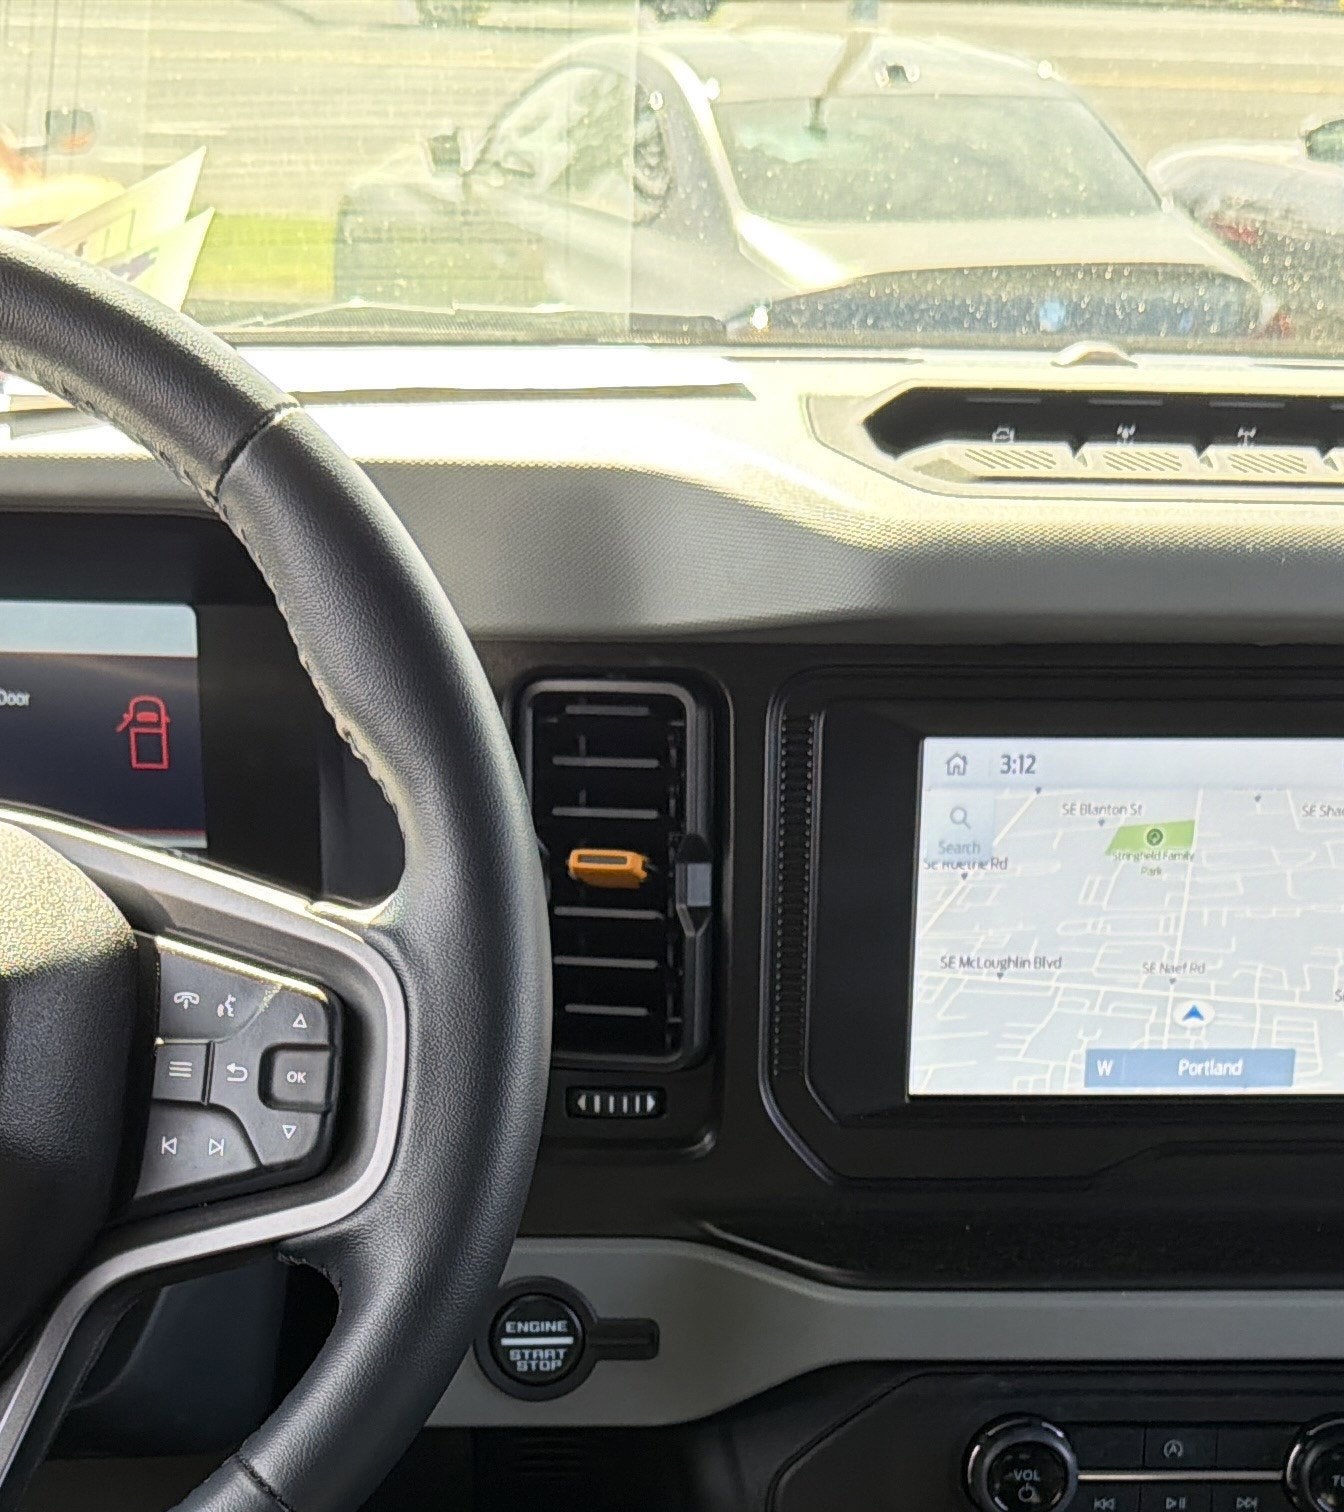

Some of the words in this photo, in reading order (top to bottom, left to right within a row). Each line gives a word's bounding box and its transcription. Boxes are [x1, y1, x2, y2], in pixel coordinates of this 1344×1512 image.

[999, 754, 1037, 775] 3:12
[1062, 803, 1077, 816] SE
[1079, 803, 1120, 816] Blanton
[1123, 803, 1143, 816] St
[1301, 804, 1317, 817] SE
[938, 840, 981, 855] Search
[940, 957, 956, 969] SE
[959, 956, 1031, 971] McLoughlin
[1034, 956, 1063, 969] Blvd
[1142, 962, 1157, 974] SE
[1189, 962, 1205, 974] Rd
[1096, 1059, 1113, 1077] W
[1178, 1058, 1243, 1077] Portland
[286, 1071, 307, 1084] OK
[506, 1320, 568, 1333] ENGINE
[509, 1349, 567, 1361] START
[516, 1360, 563, 1372] STOP
[1014, 1469, 1040, 1481] VOL
